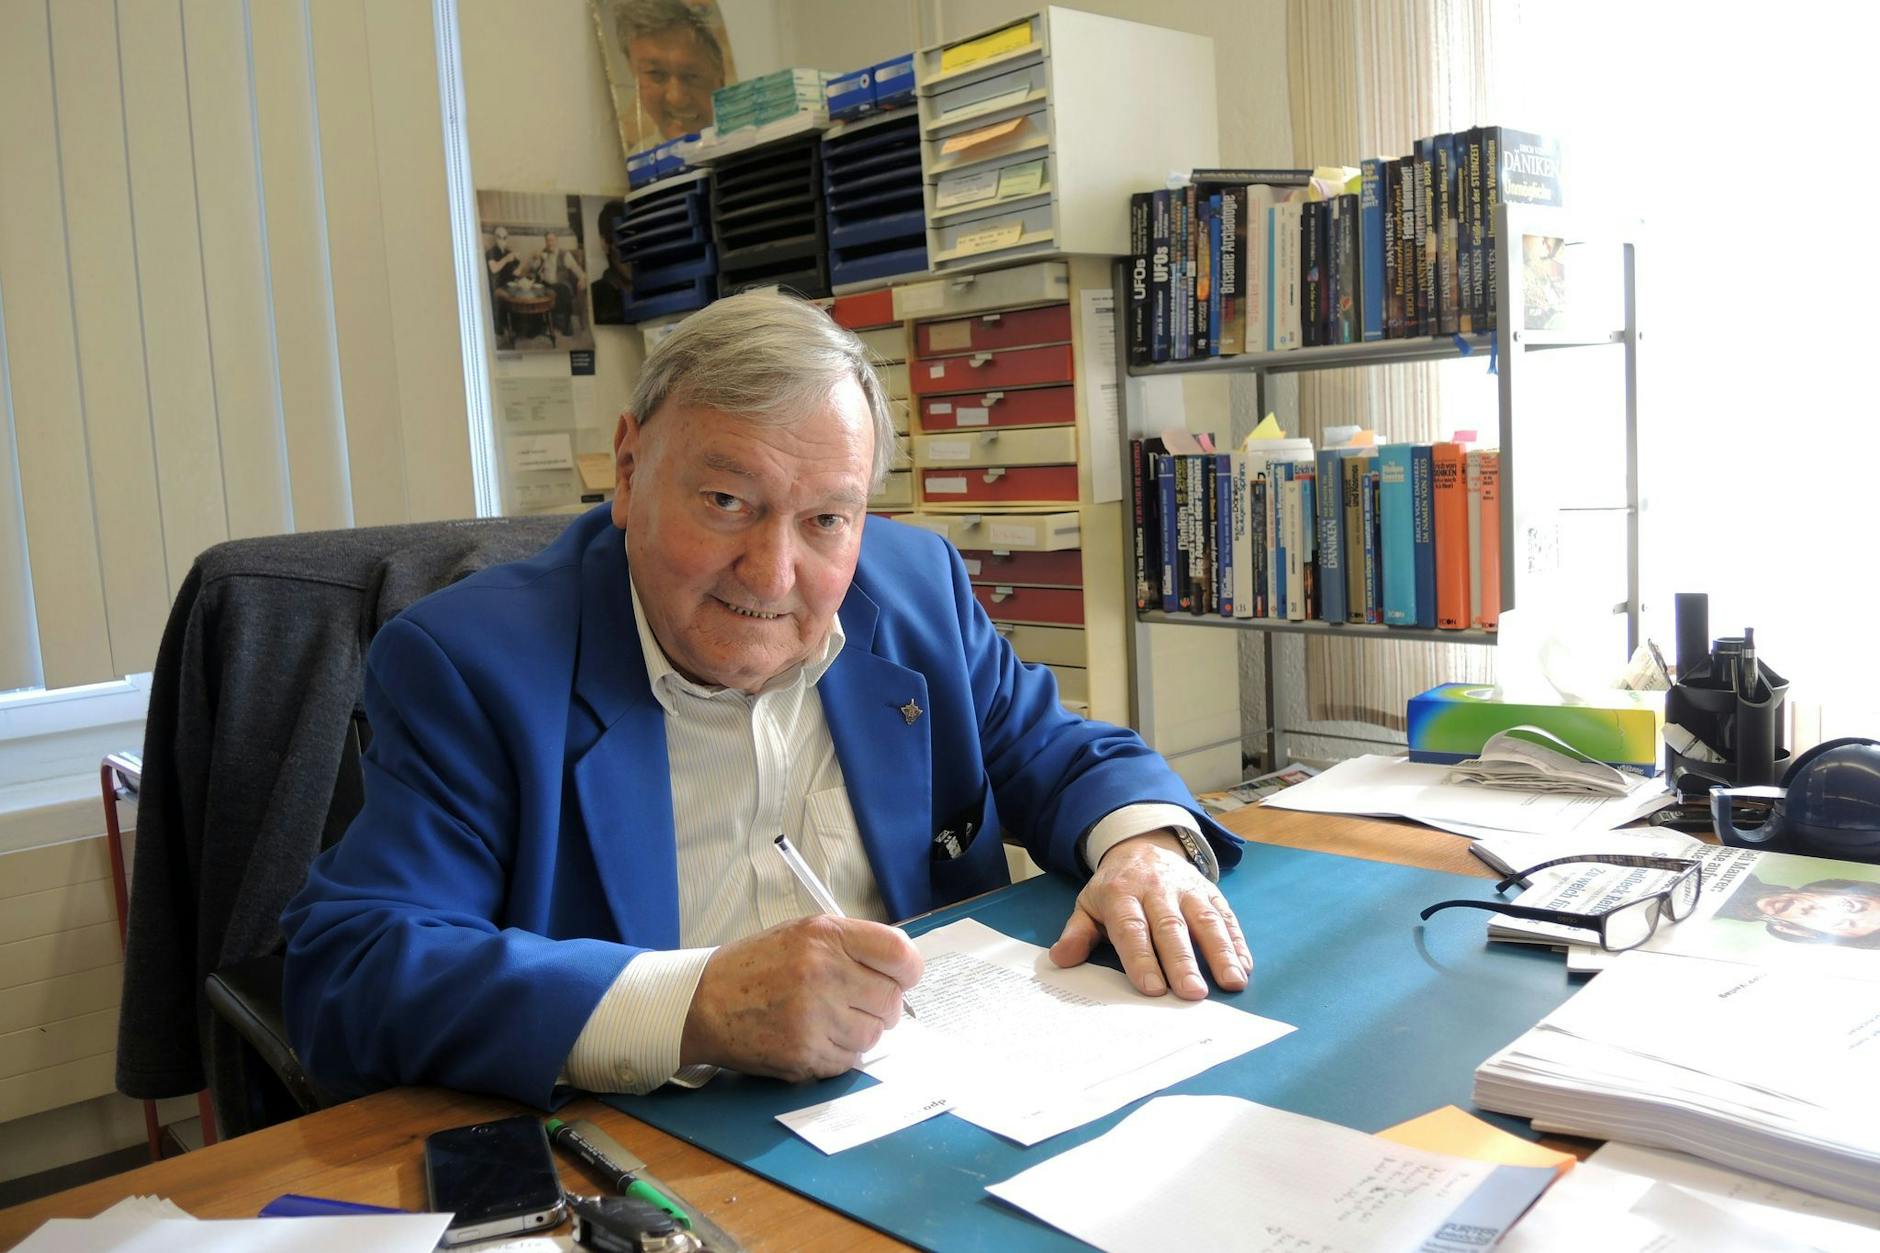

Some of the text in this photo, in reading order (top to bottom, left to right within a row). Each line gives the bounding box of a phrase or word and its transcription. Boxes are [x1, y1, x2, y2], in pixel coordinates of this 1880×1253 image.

[1503, 148, 1560, 177] DÄNIKEN
[1133, 259, 1147, 300] UFOs
[1153, 246, 1169, 282] UFOs
[1221, 254, 1235, 294] Brisante
[1192, 458, 1204, 577] Die Augen der Sphinx
